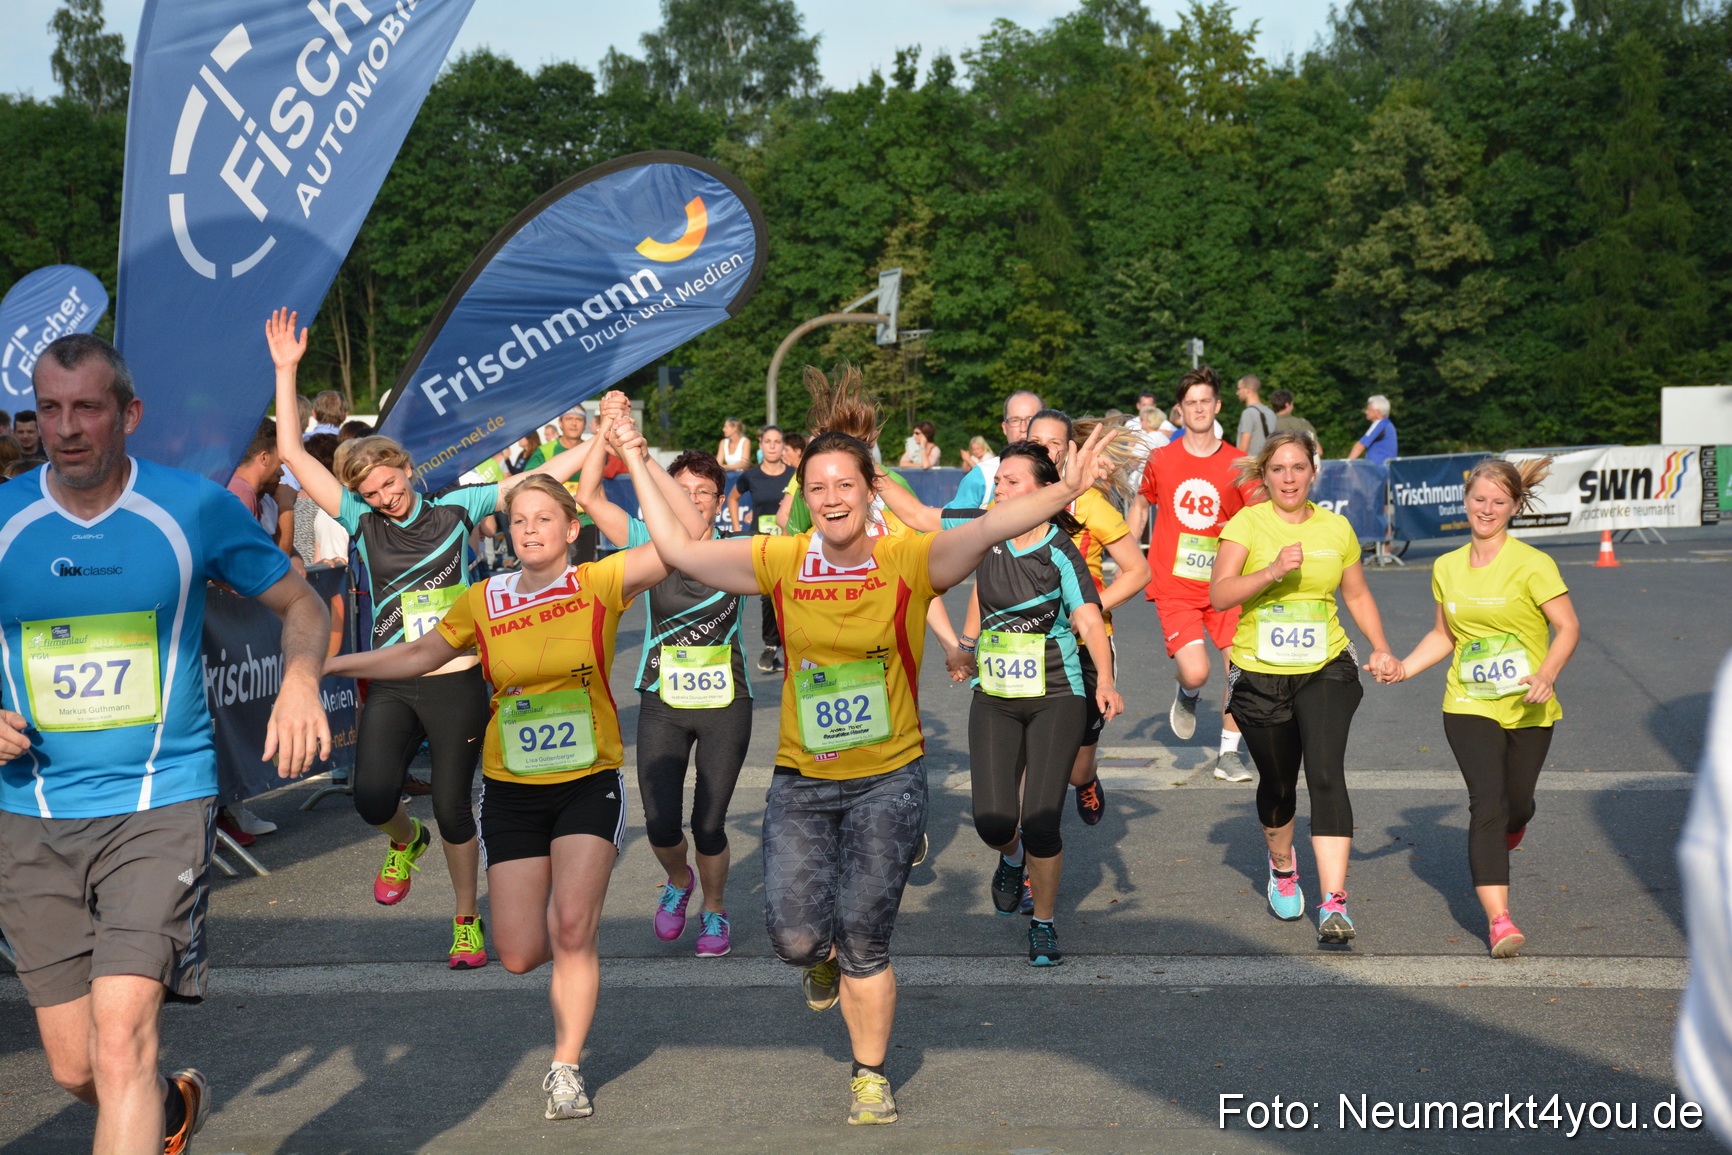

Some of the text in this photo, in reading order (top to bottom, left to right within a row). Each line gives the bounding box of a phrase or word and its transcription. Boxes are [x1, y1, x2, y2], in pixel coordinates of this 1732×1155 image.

[580, 253, 744, 353] Druck und Medien
[420, 268, 663, 416] Frischmann
[1579, 467, 1653, 504] swn
[1179, 490, 1215, 518] 48
[83, 565, 123, 576] classic
[424, 551, 461, 590] Donauer
[793, 588, 839, 600] MAX
[490, 597, 590, 637] MAX BÖGL
[690, 629, 700, 641] &
[698, 597, 738, 635] Donauer
[1270, 627, 1316, 648] 645
[53, 659, 131, 700] 527
[668, 670, 727, 692] 1363
[983, 656, 1038, 679] 1348
[1472, 658, 1517, 684] 646
[58, 703, 131, 716] Markus Guthmann
[816, 694, 872, 729] 882
[518, 721, 578, 753] 922
[525, 756, 539, 764] Lisa
